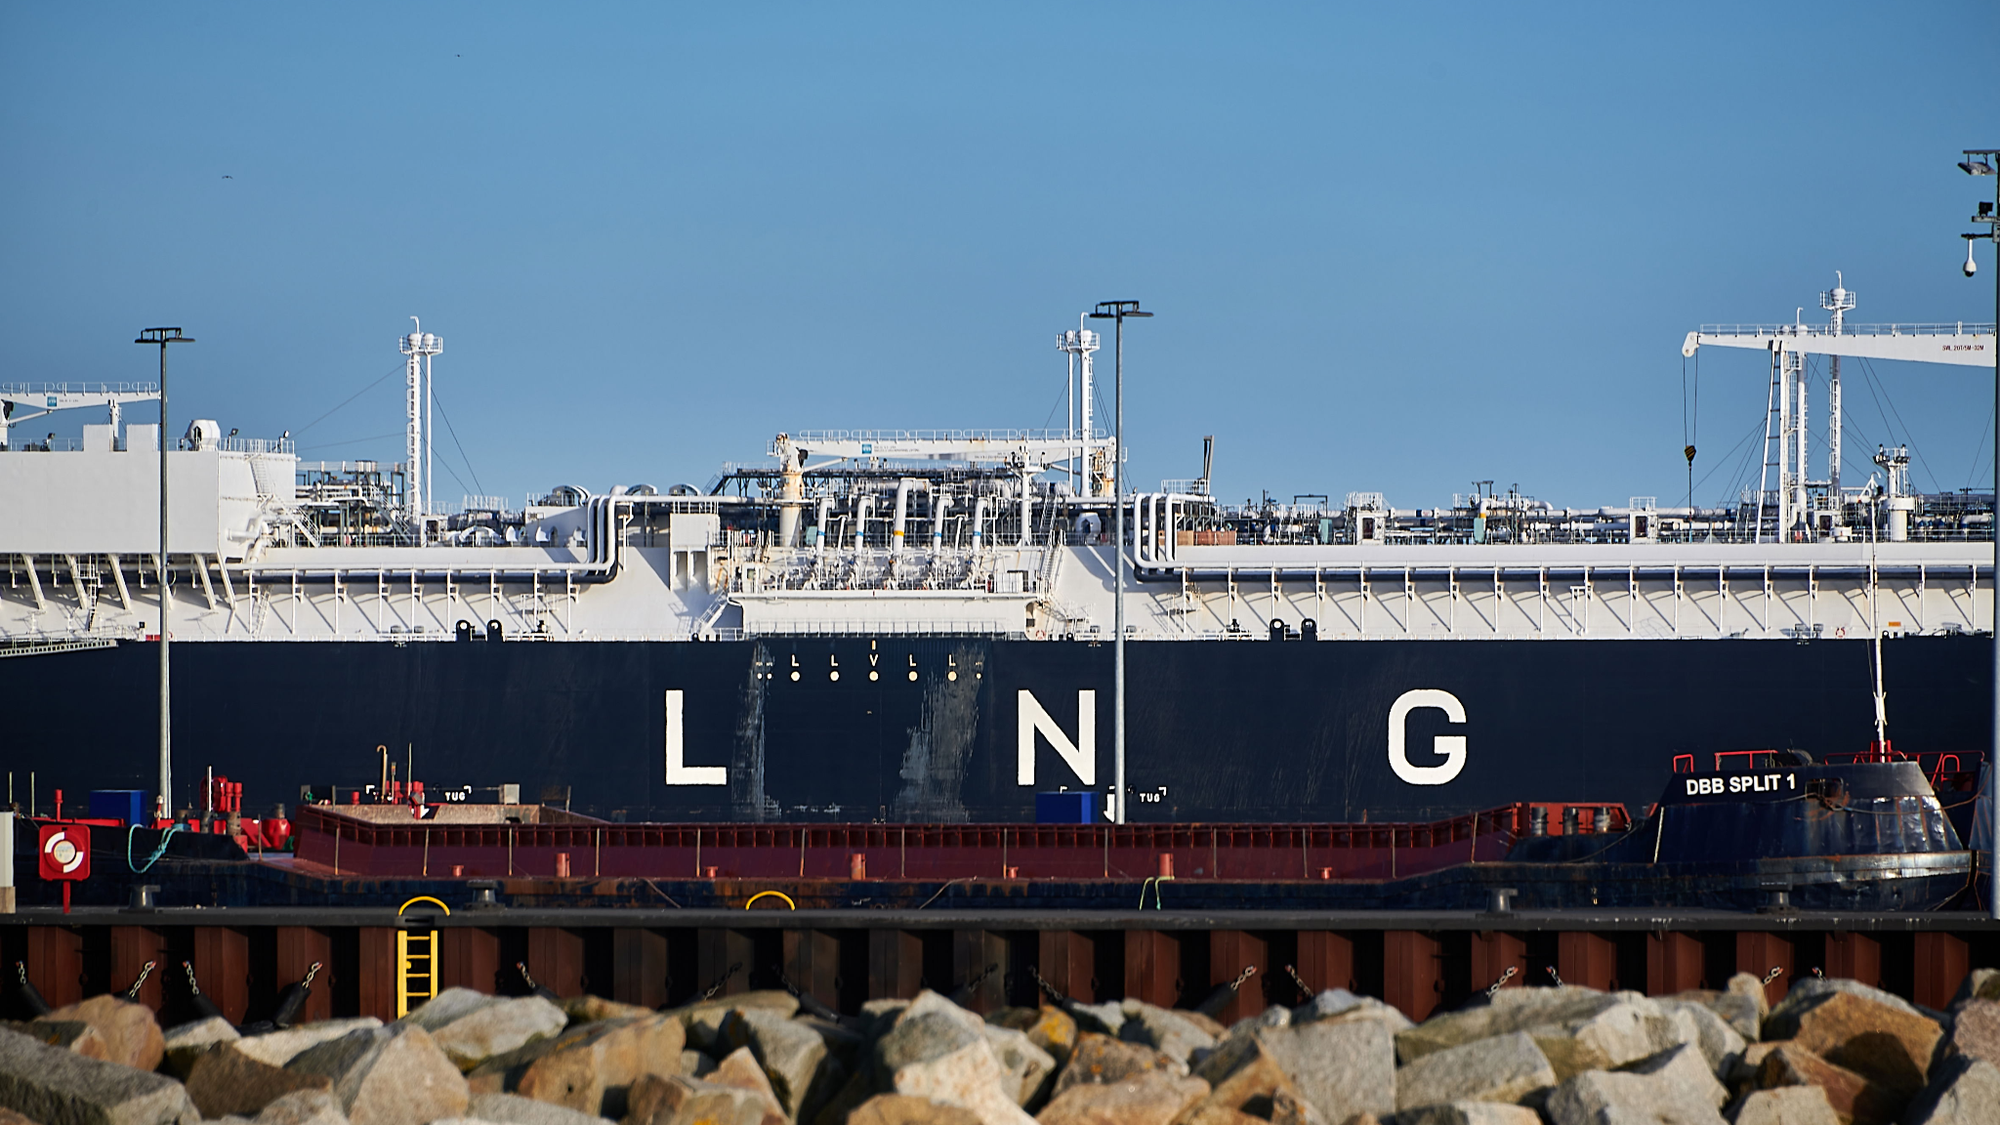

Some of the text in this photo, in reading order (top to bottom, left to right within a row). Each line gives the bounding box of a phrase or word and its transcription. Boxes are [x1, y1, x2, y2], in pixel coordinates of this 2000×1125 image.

[791, 654, 956, 666] L L V L L
[1686, 773, 1795, 795] DBB SPLIT 1
[445, 792, 466, 801] TUG
[1139, 793, 1160, 802] TUG
